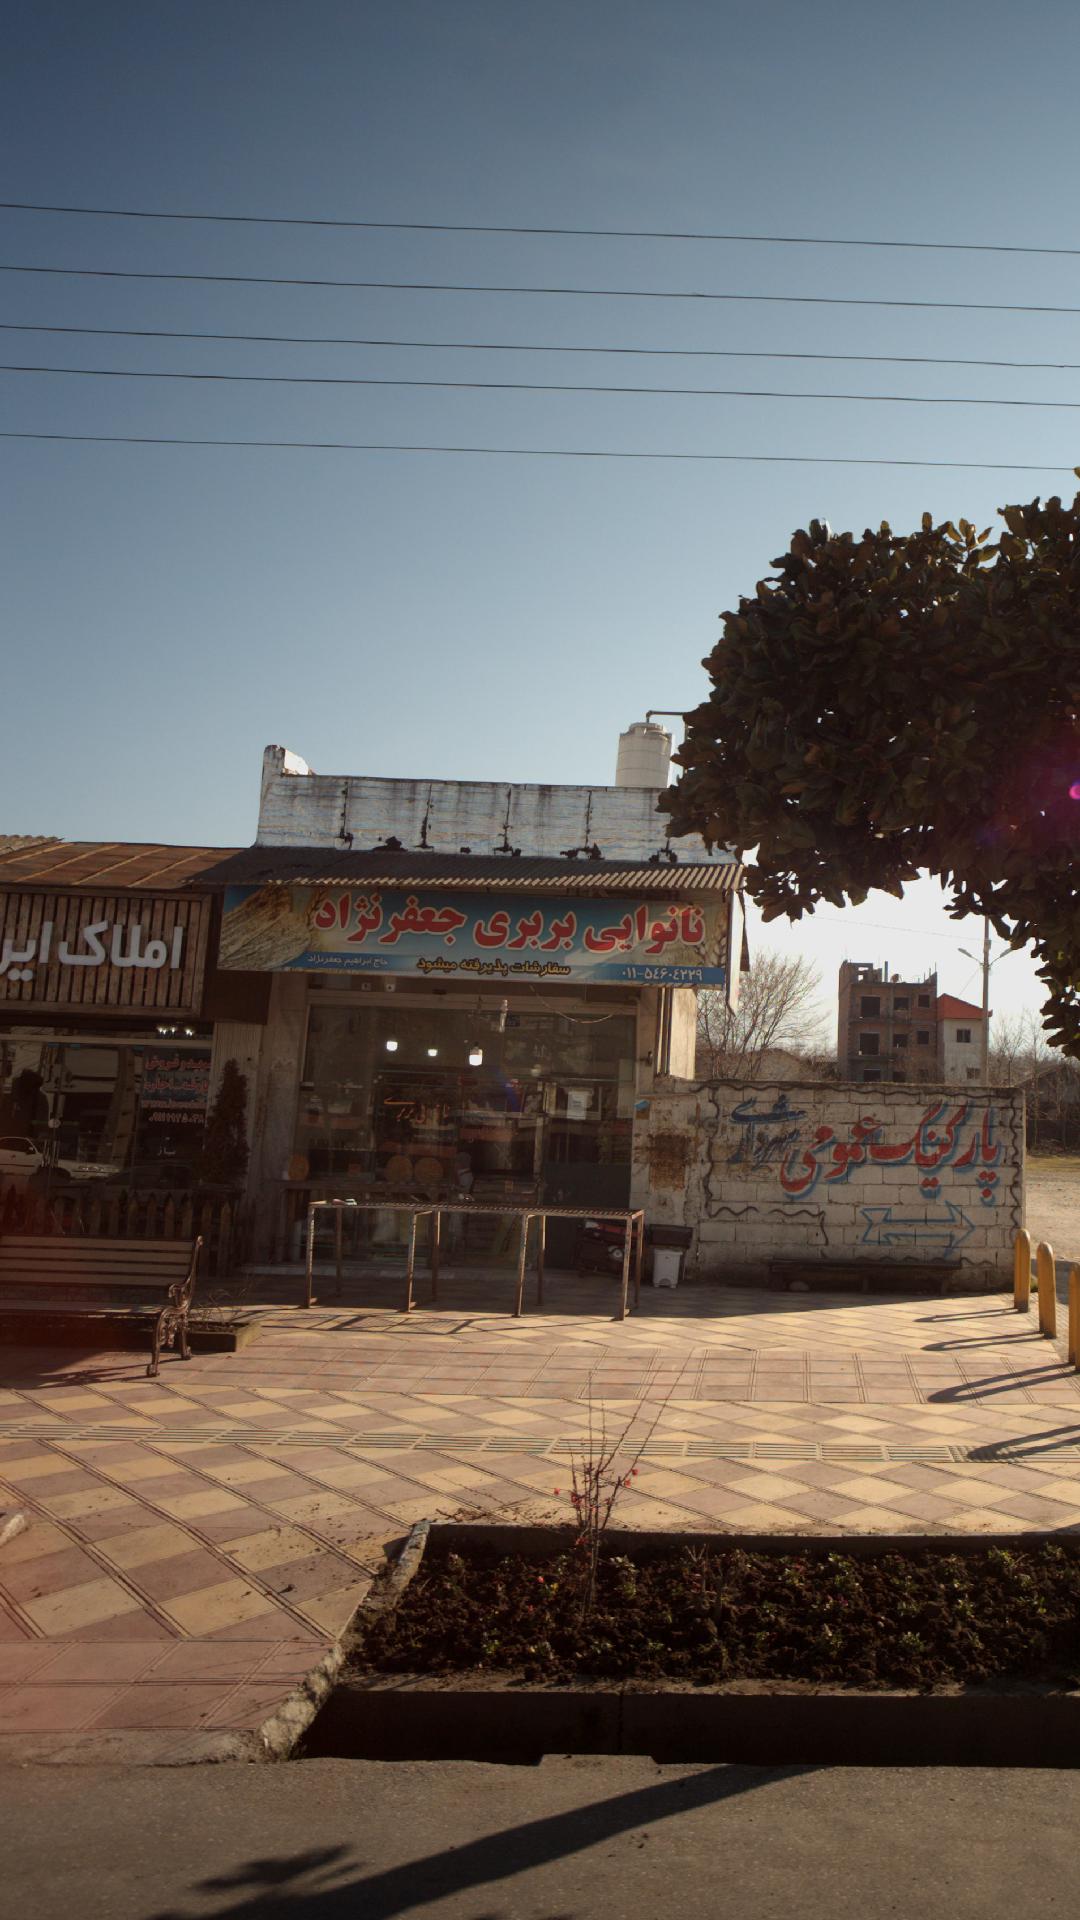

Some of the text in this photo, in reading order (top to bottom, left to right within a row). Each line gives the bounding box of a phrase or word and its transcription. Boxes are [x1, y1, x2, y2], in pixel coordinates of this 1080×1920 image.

[58, 919, 184, 969] املاک
[314, 891, 705, 956] نانوایی بربری جعفرنژاد
[416, 956, 571, 977] سفارشات پذیرفته میشود
[867, 1098, 1000, 1203] پارکینگ
